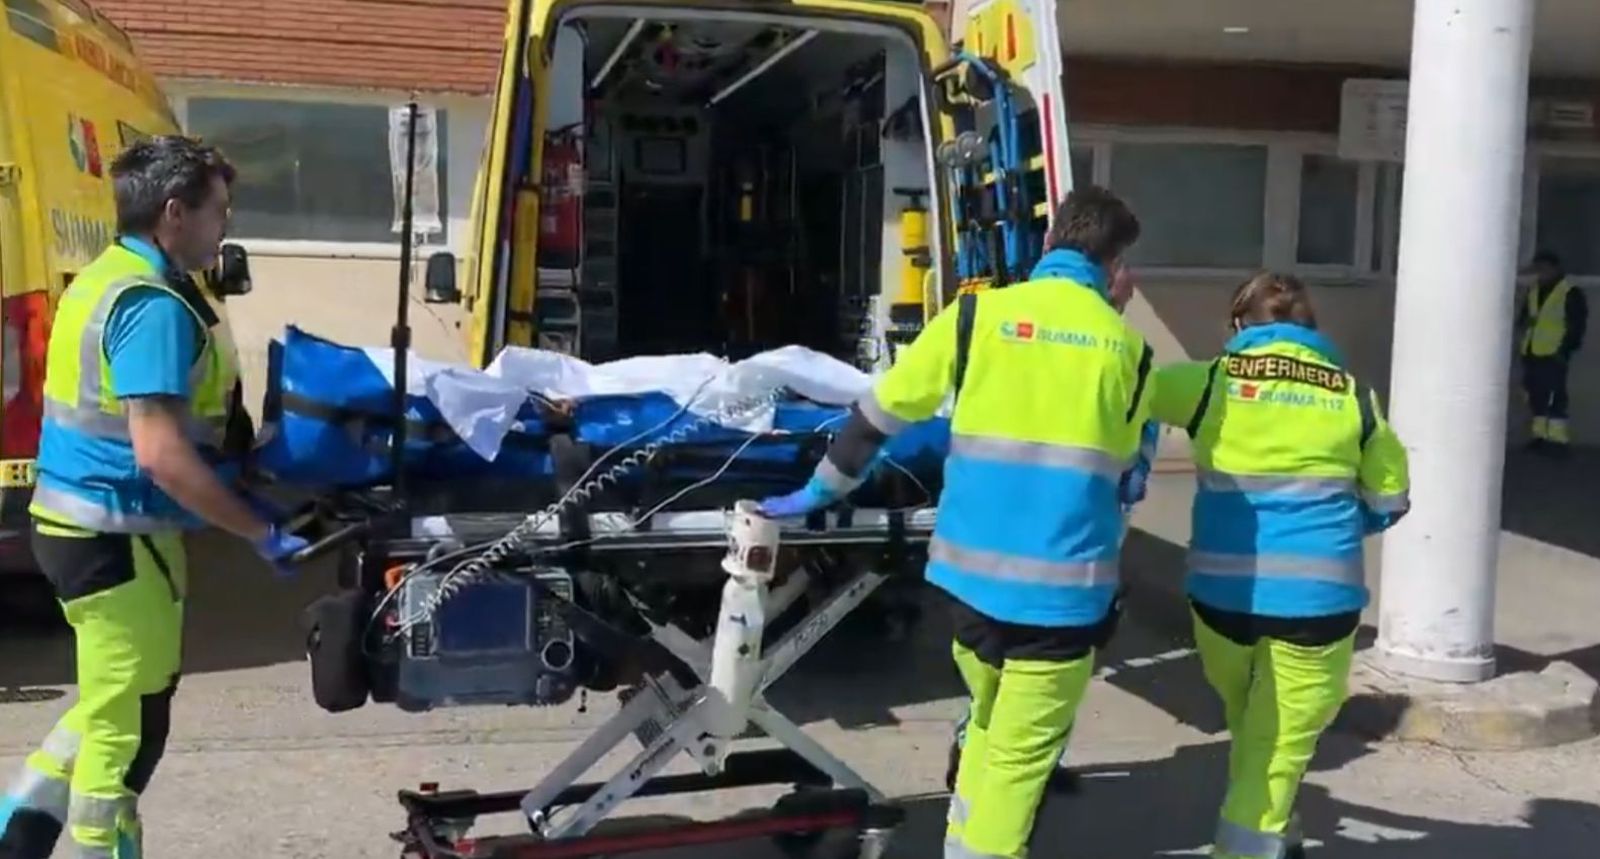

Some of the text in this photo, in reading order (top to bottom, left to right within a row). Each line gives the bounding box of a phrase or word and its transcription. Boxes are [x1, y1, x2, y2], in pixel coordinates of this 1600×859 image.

[1036, 328, 1098, 349] SUMMA
[1227, 357, 1345, 390] ENFERMERA
[1258, 390, 1345, 411] SUMMA 112
